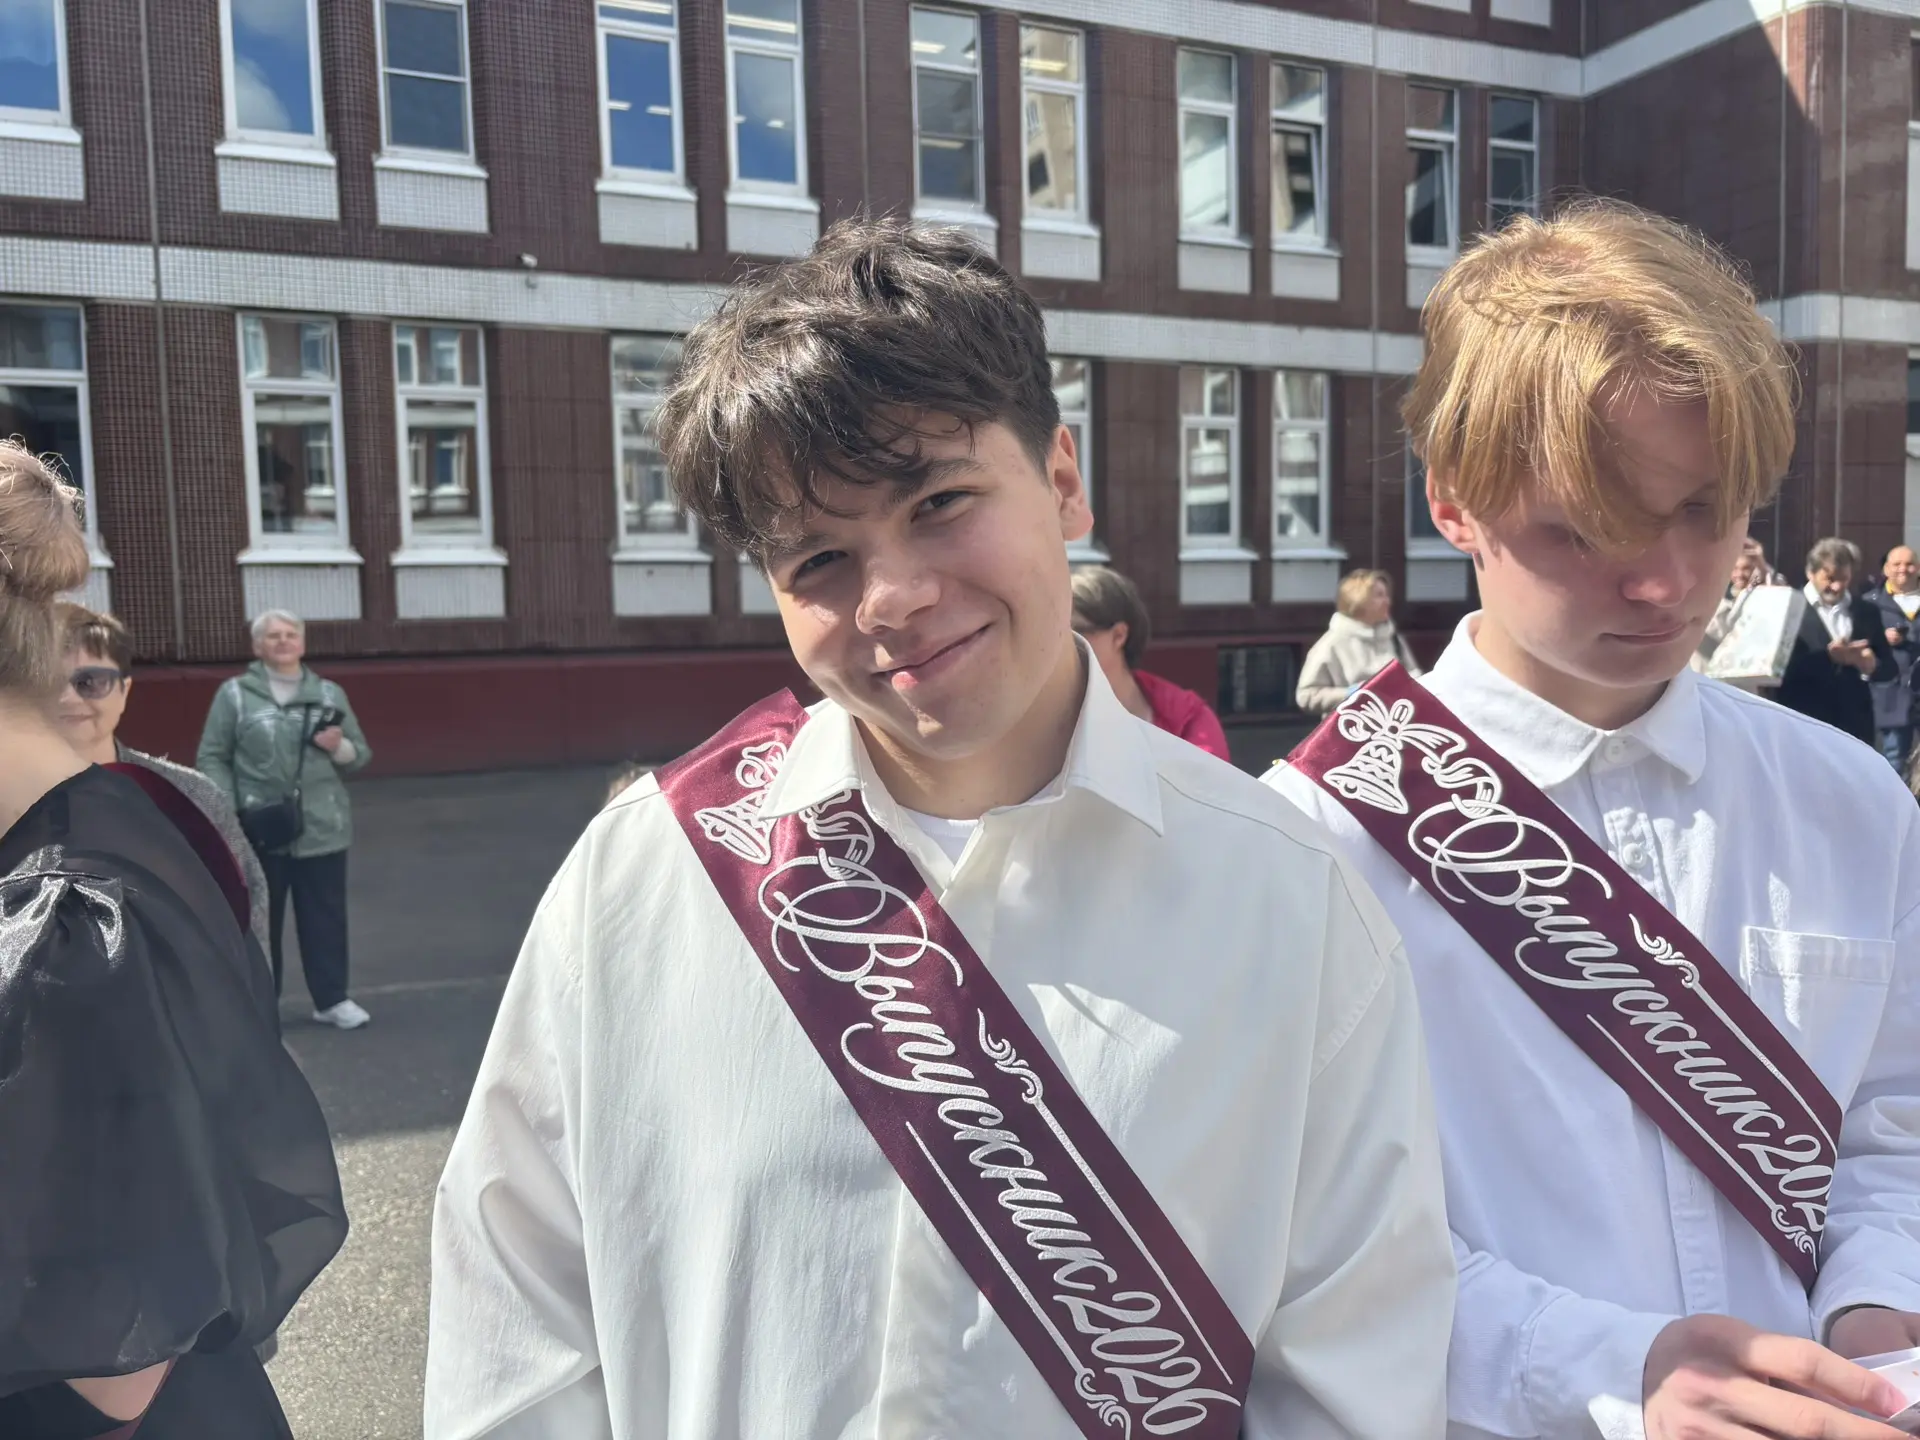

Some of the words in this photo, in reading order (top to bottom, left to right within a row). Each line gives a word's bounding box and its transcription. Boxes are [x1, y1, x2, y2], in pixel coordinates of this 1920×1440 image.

[757, 855, 1118, 1291] Выпускник
[1052, 1291, 1242, 1436] 2026
[1407, 800, 1786, 1138] Выпускник
